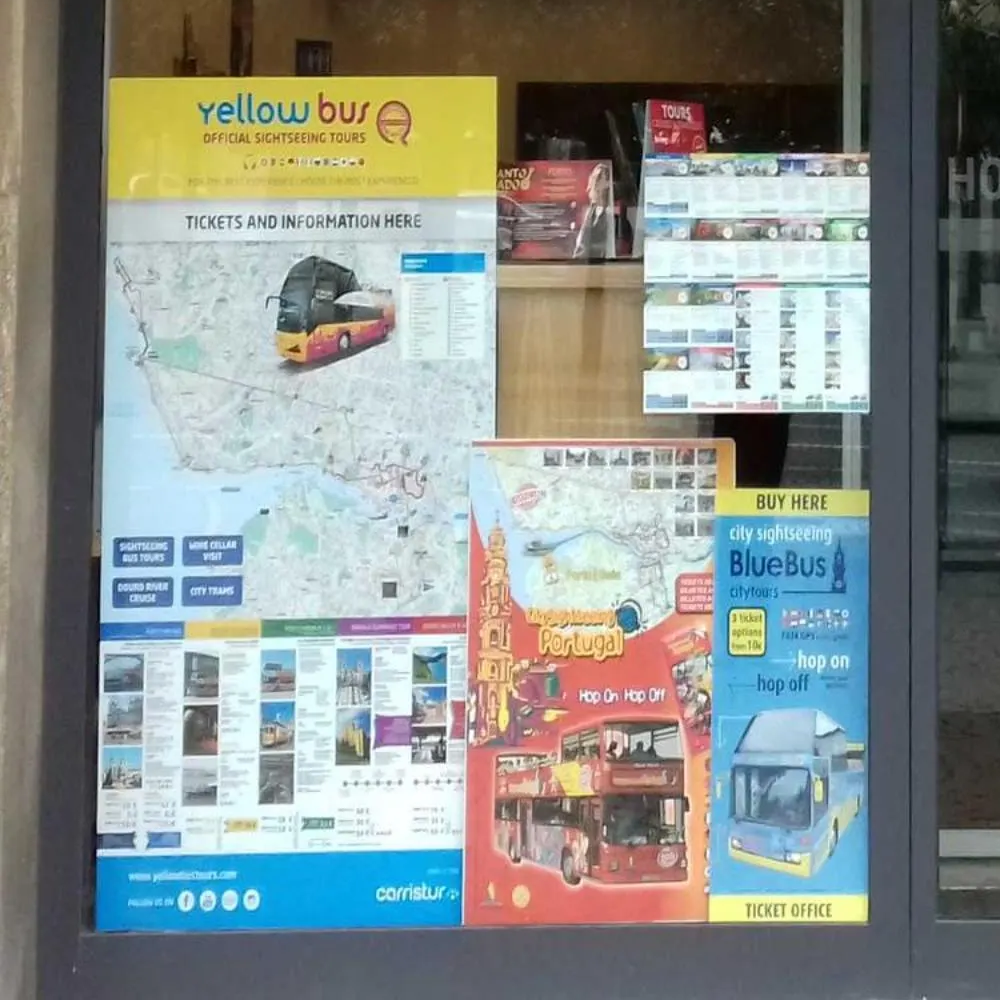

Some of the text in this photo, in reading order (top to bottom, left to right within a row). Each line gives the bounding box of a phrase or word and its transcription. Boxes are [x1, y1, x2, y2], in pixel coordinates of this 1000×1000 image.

[318, 91, 371, 125] bus
[661, 103, 693, 122] TOURS
[203, 131, 366, 144] OFFICIAL SIGHTSEEING TOURS
[185, 213, 422, 230] TICKETS AND INFORMATION HERE
[756, 493, 829, 511] BUY HERE
[729, 523, 832, 546] city sightseeing
[729, 549, 827, 578] BlueBus
[539, 627, 625, 661] Portugal
[797, 649, 850, 673] hop on
[579, 687, 667, 704] Hop On Hop Off
[756, 673, 785, 696] hop
[789, 673, 811, 692] off
[375, 881, 447, 903] carristur
[745, 903, 833, 919] TICKET OFFICE
